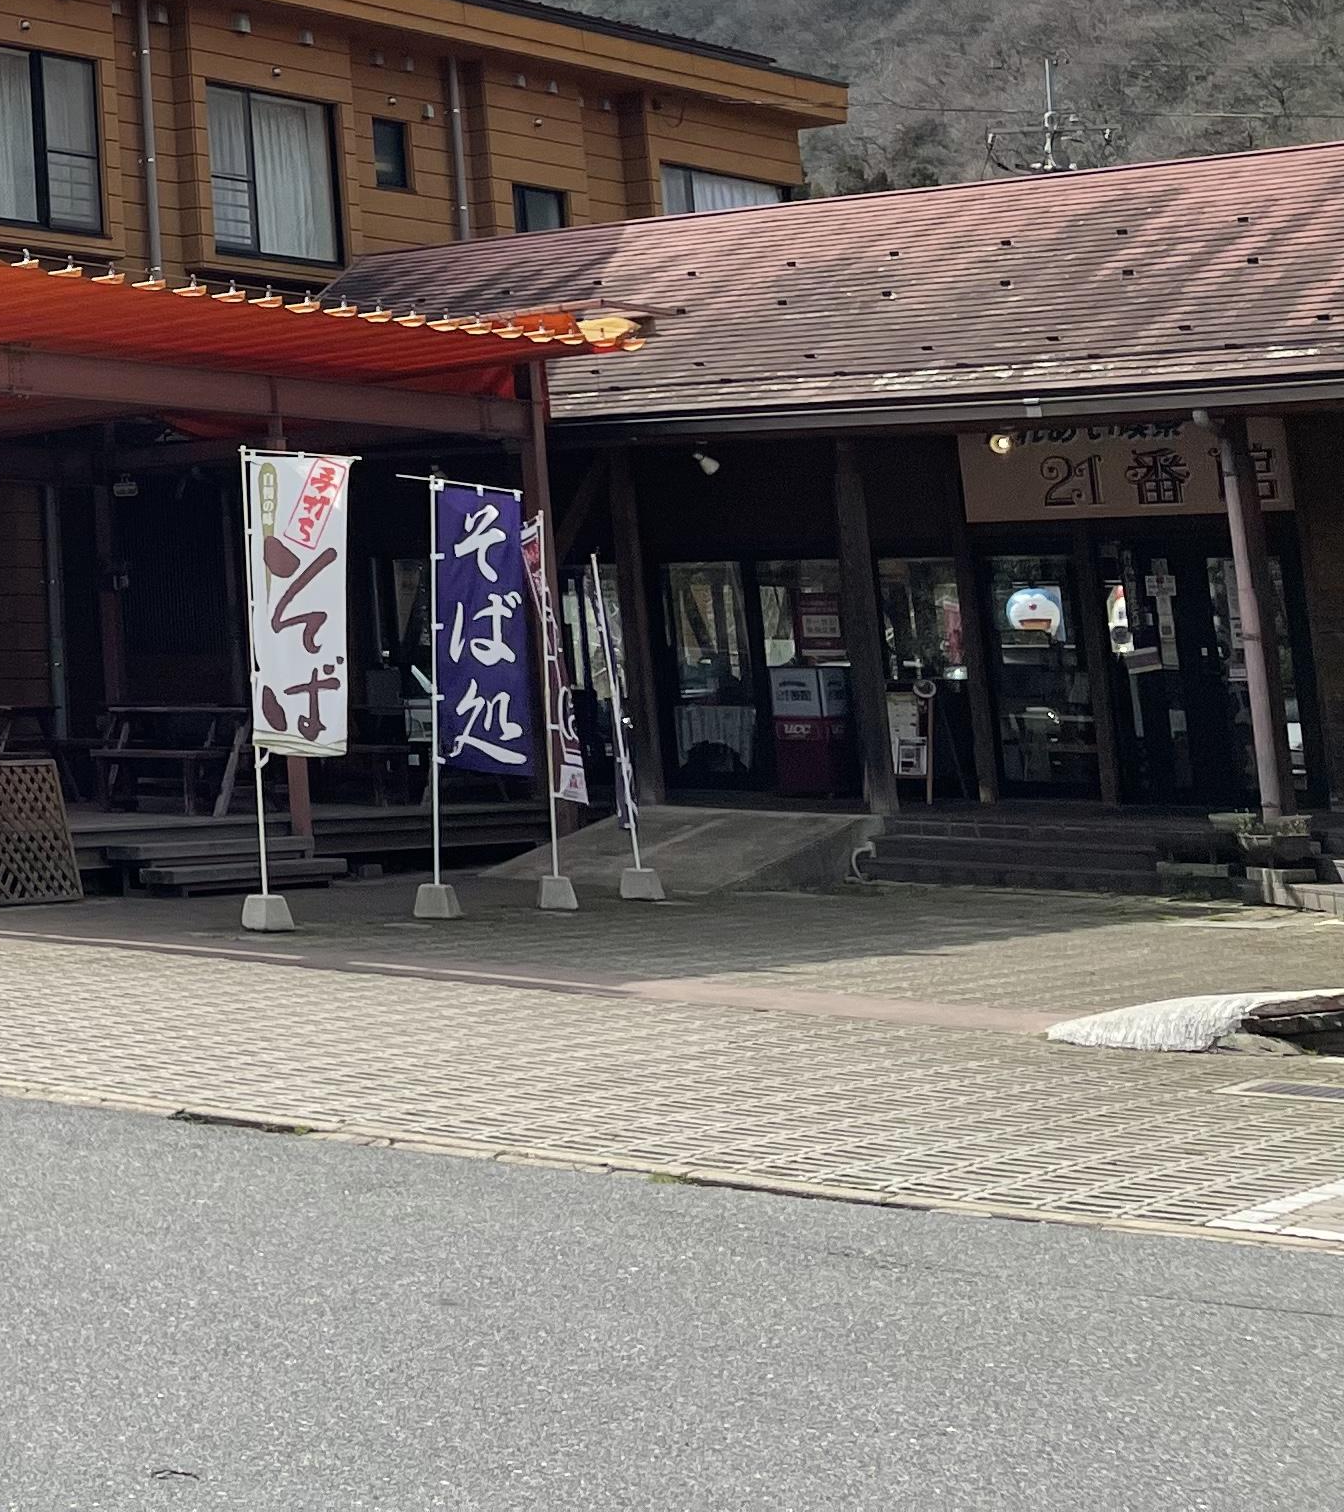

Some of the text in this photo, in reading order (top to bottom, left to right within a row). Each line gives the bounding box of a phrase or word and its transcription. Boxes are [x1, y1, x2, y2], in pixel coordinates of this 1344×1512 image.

[262, 535, 344, 742] そば
[449, 504, 528, 764] そば処
